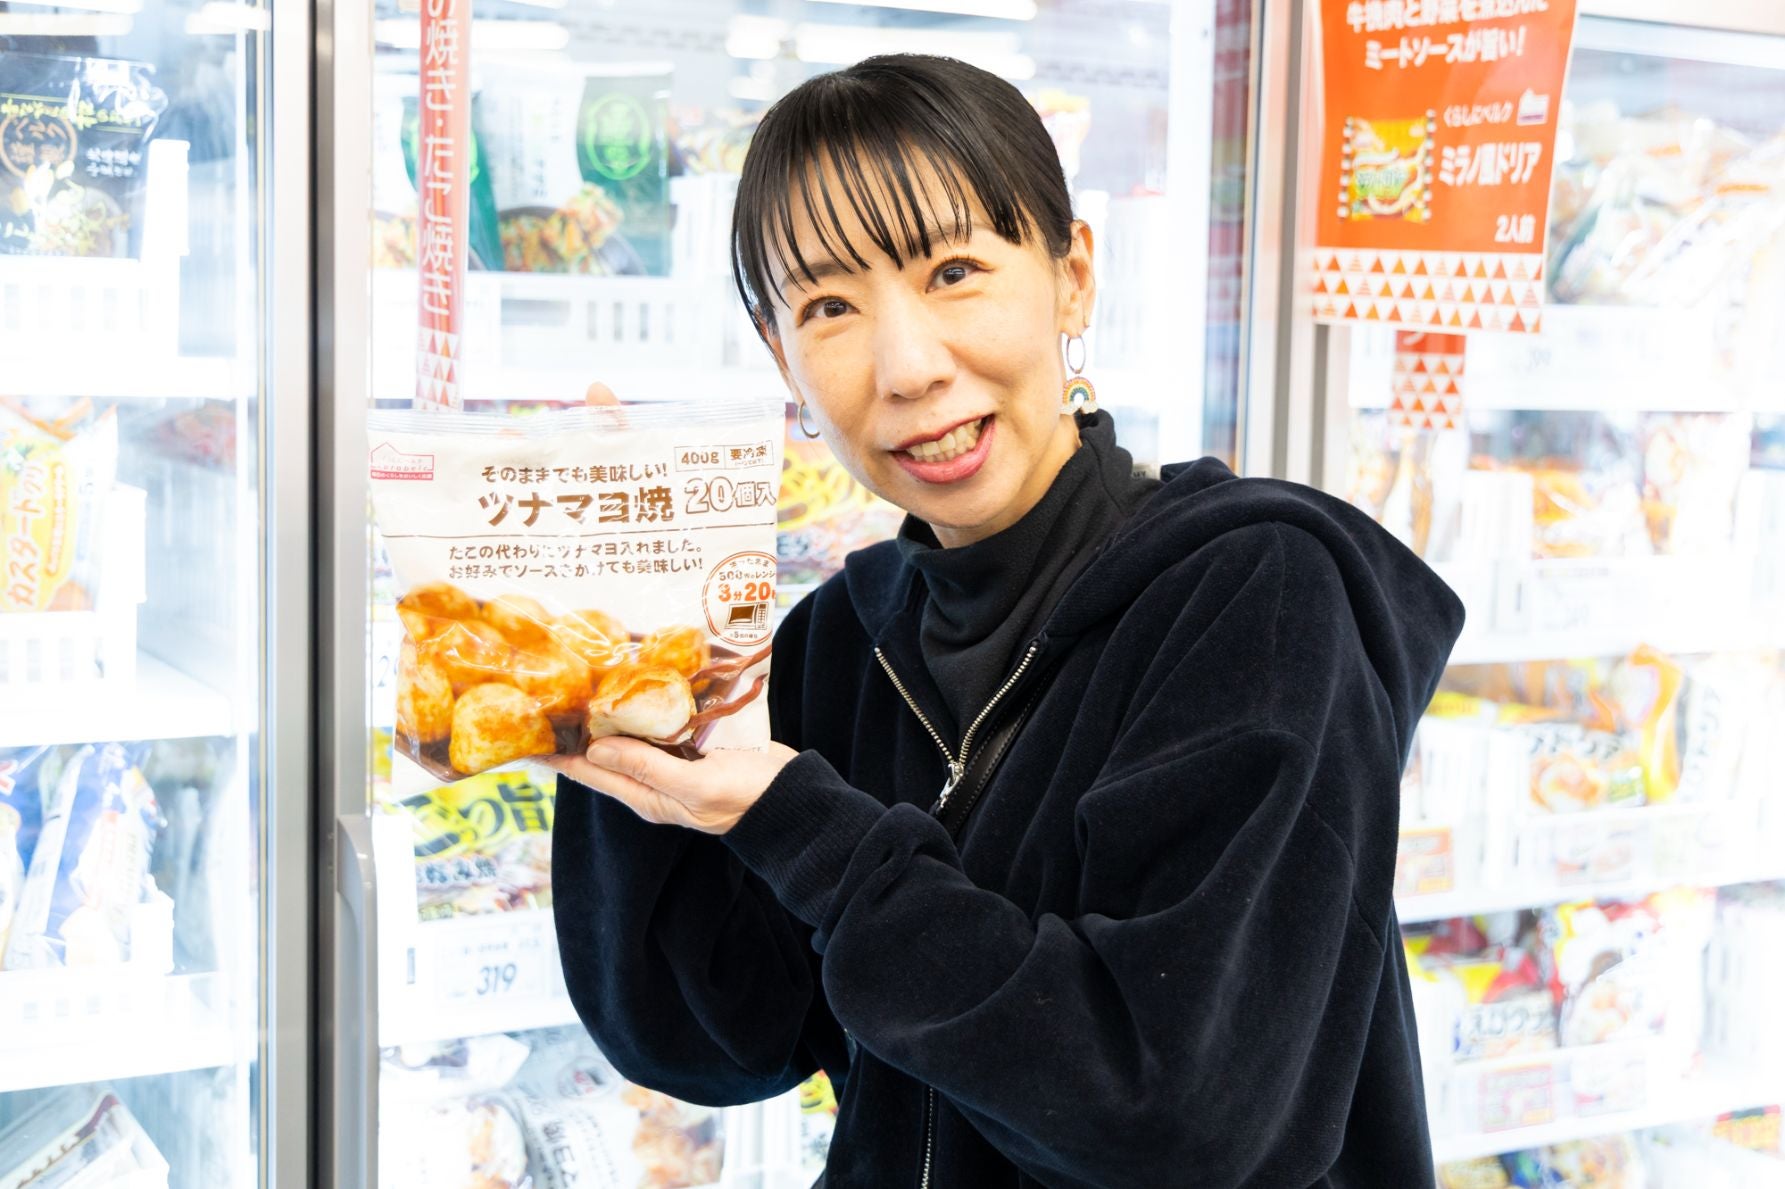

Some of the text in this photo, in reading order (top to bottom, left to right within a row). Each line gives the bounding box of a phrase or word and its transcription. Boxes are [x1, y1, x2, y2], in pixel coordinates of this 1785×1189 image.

[1438, 142, 1542, 187] ミラノ風ドリア
[1494, 214, 1536, 243] 2人前
[681, 451, 720, 465] 400g
[481, 463, 668, 484] そのままでも美味しい!
[478, 485, 675, 527] ツナマヨ焼
[684, 475, 777, 515] 20個入
[449, 539, 702, 561] たこの代わりにツナマヨ入れました。
[449, 557, 703, 580] お好みでソースをかけても美味しい!
[476, 961, 518, 996] 319
